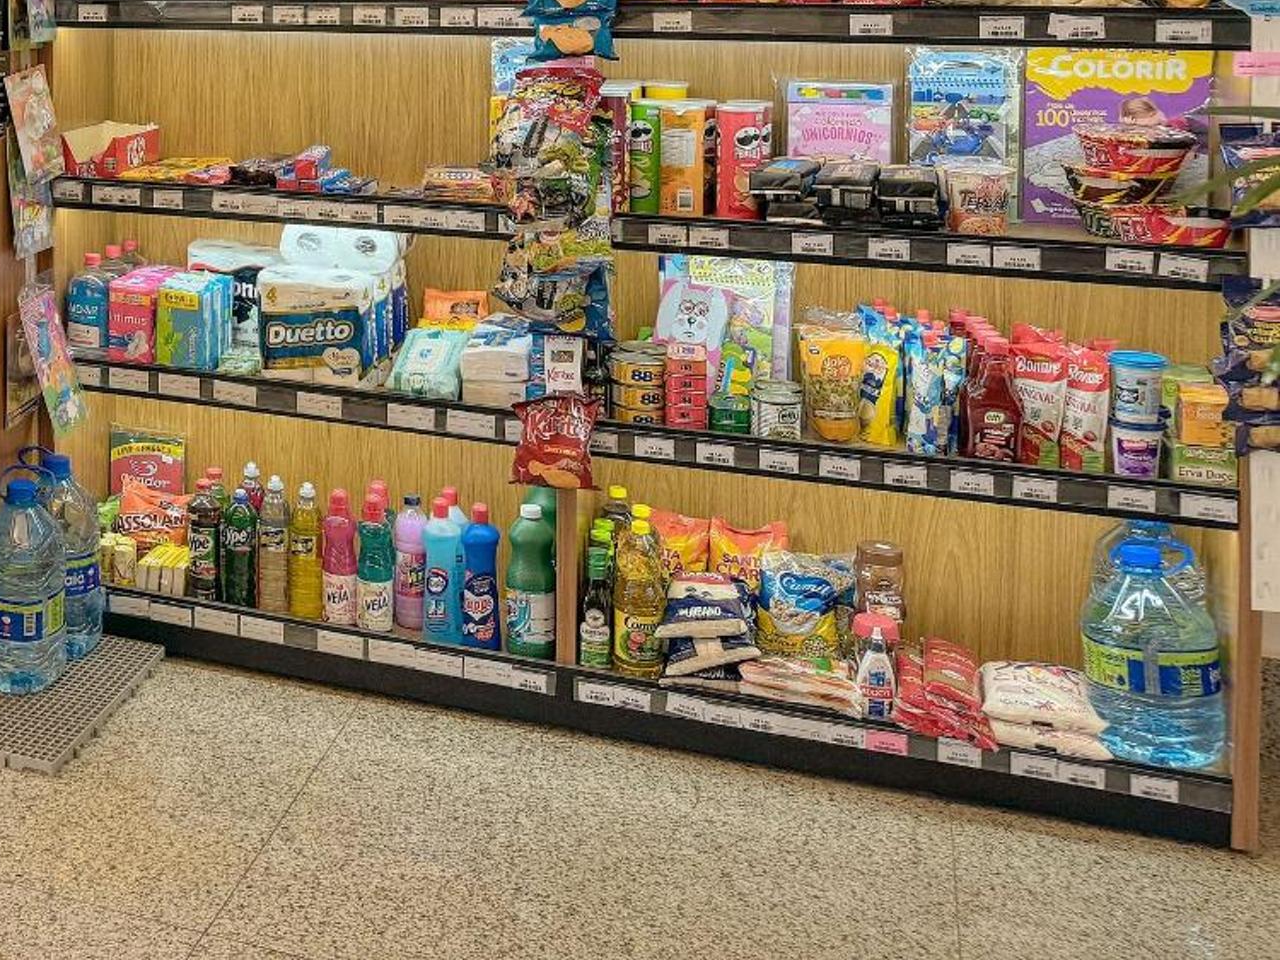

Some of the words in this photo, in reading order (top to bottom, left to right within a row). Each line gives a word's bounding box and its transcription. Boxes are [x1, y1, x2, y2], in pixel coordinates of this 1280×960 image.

[1050, 54, 1188, 81] COLORIR
[1035, 108, 1069, 127] 100
[269, 319, 353, 345] Duetto
[1179, 467, 1203, 478] Erva
[1206, 469, 1234, 482] Doce
[716, 563, 761, 581] CLAR
